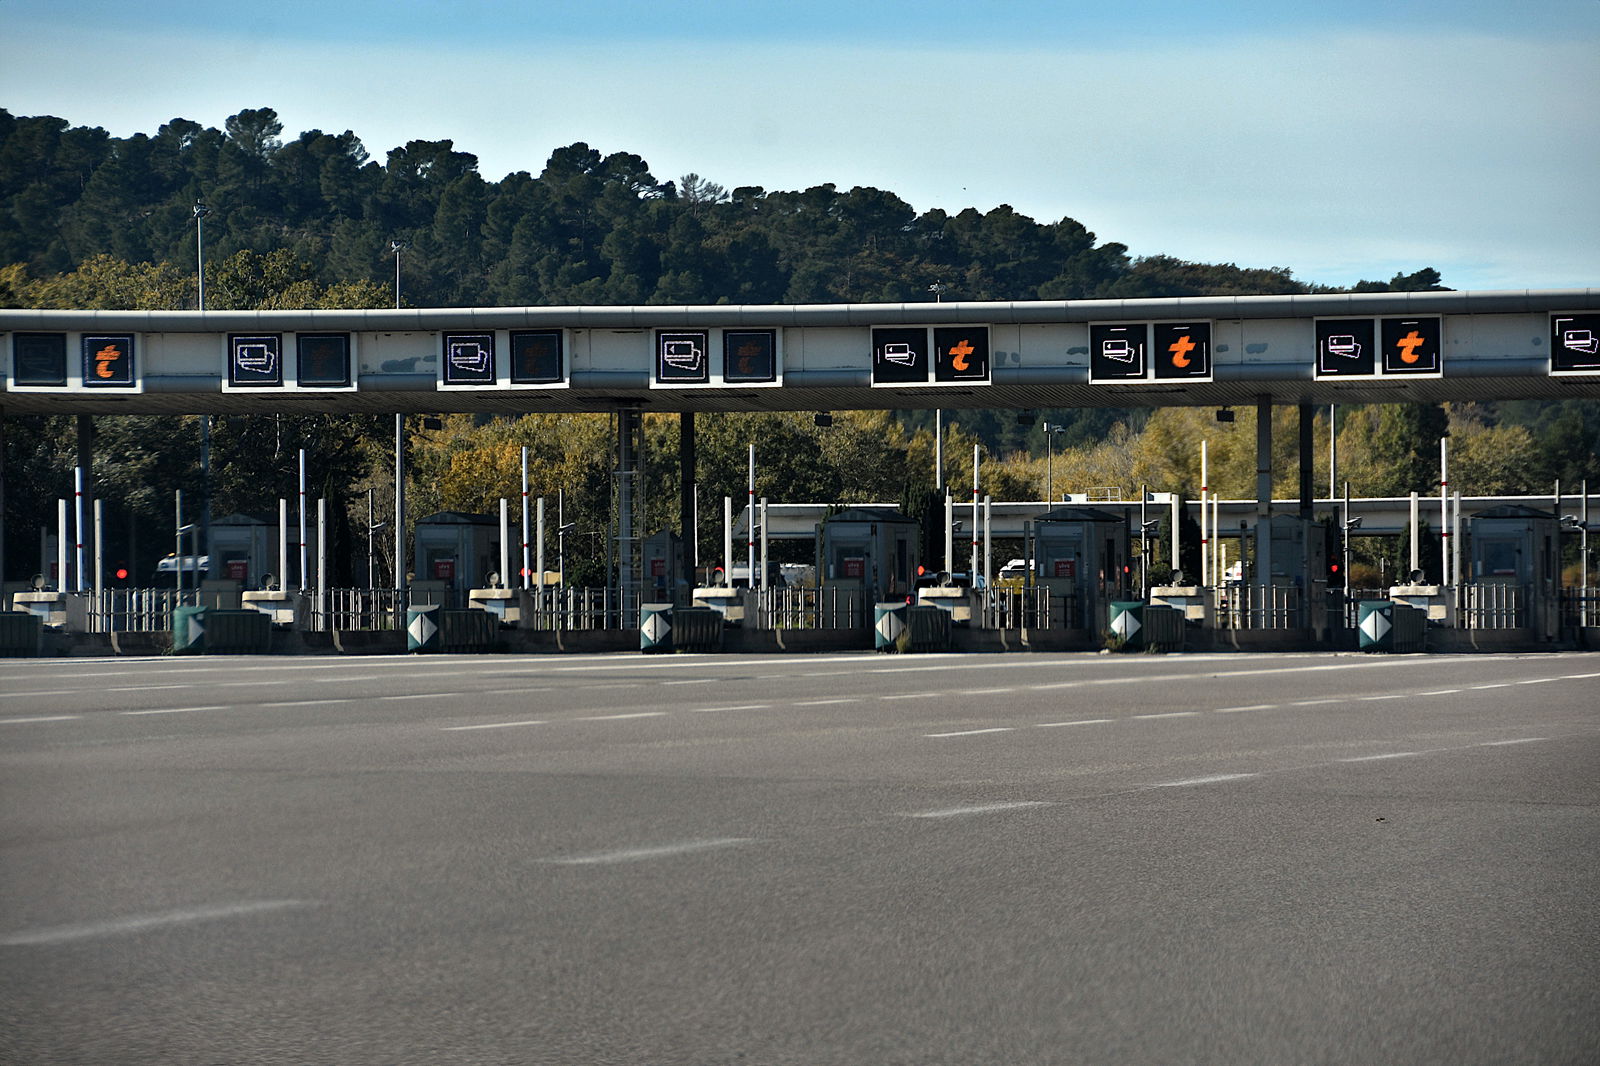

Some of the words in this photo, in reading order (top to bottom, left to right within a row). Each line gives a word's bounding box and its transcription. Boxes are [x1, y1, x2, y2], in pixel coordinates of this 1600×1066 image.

[948, 339, 975, 371] t
[1168, 335, 1196, 368] t
[1396, 330, 1425, 364] t
